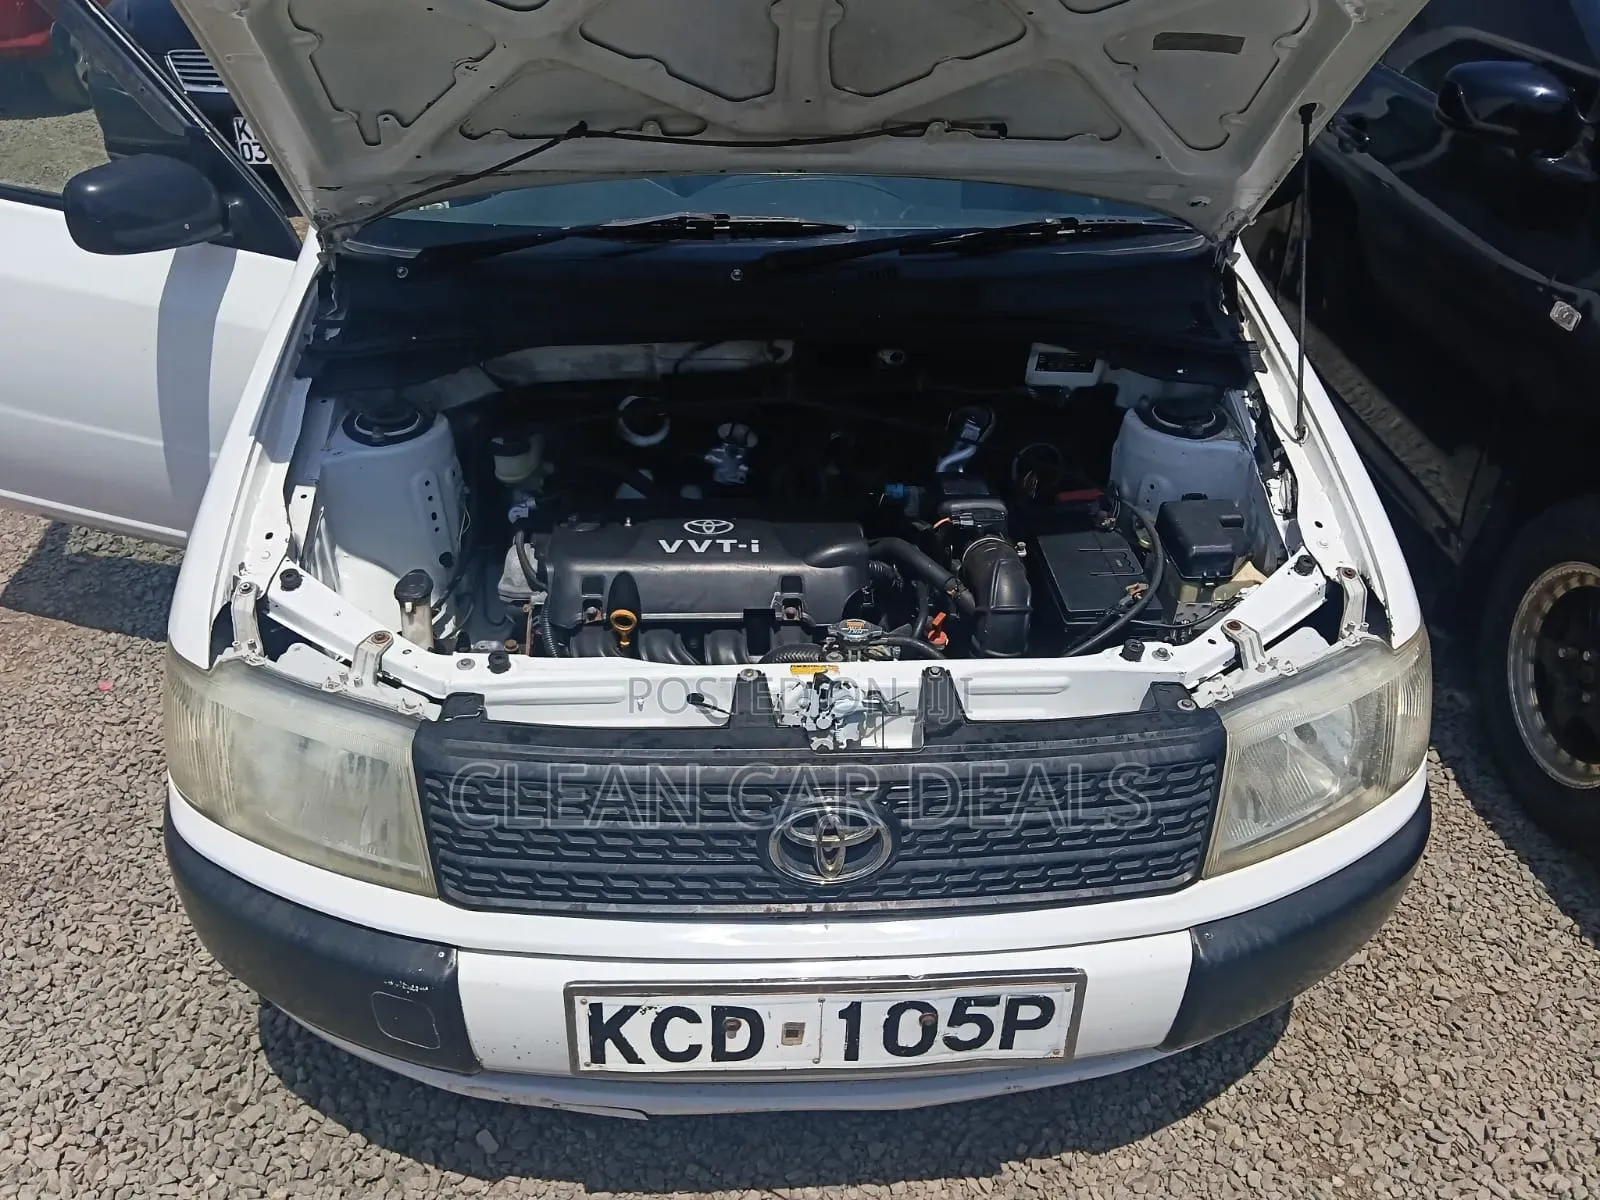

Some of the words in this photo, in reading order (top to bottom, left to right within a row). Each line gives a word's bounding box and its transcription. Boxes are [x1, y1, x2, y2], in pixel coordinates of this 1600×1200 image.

[235, 119, 257, 140] K
[658, 539, 759, 553] VVT-i
[588, 1002, 765, 1064] KCD
[838, 995, 1055, 1061] 105P
